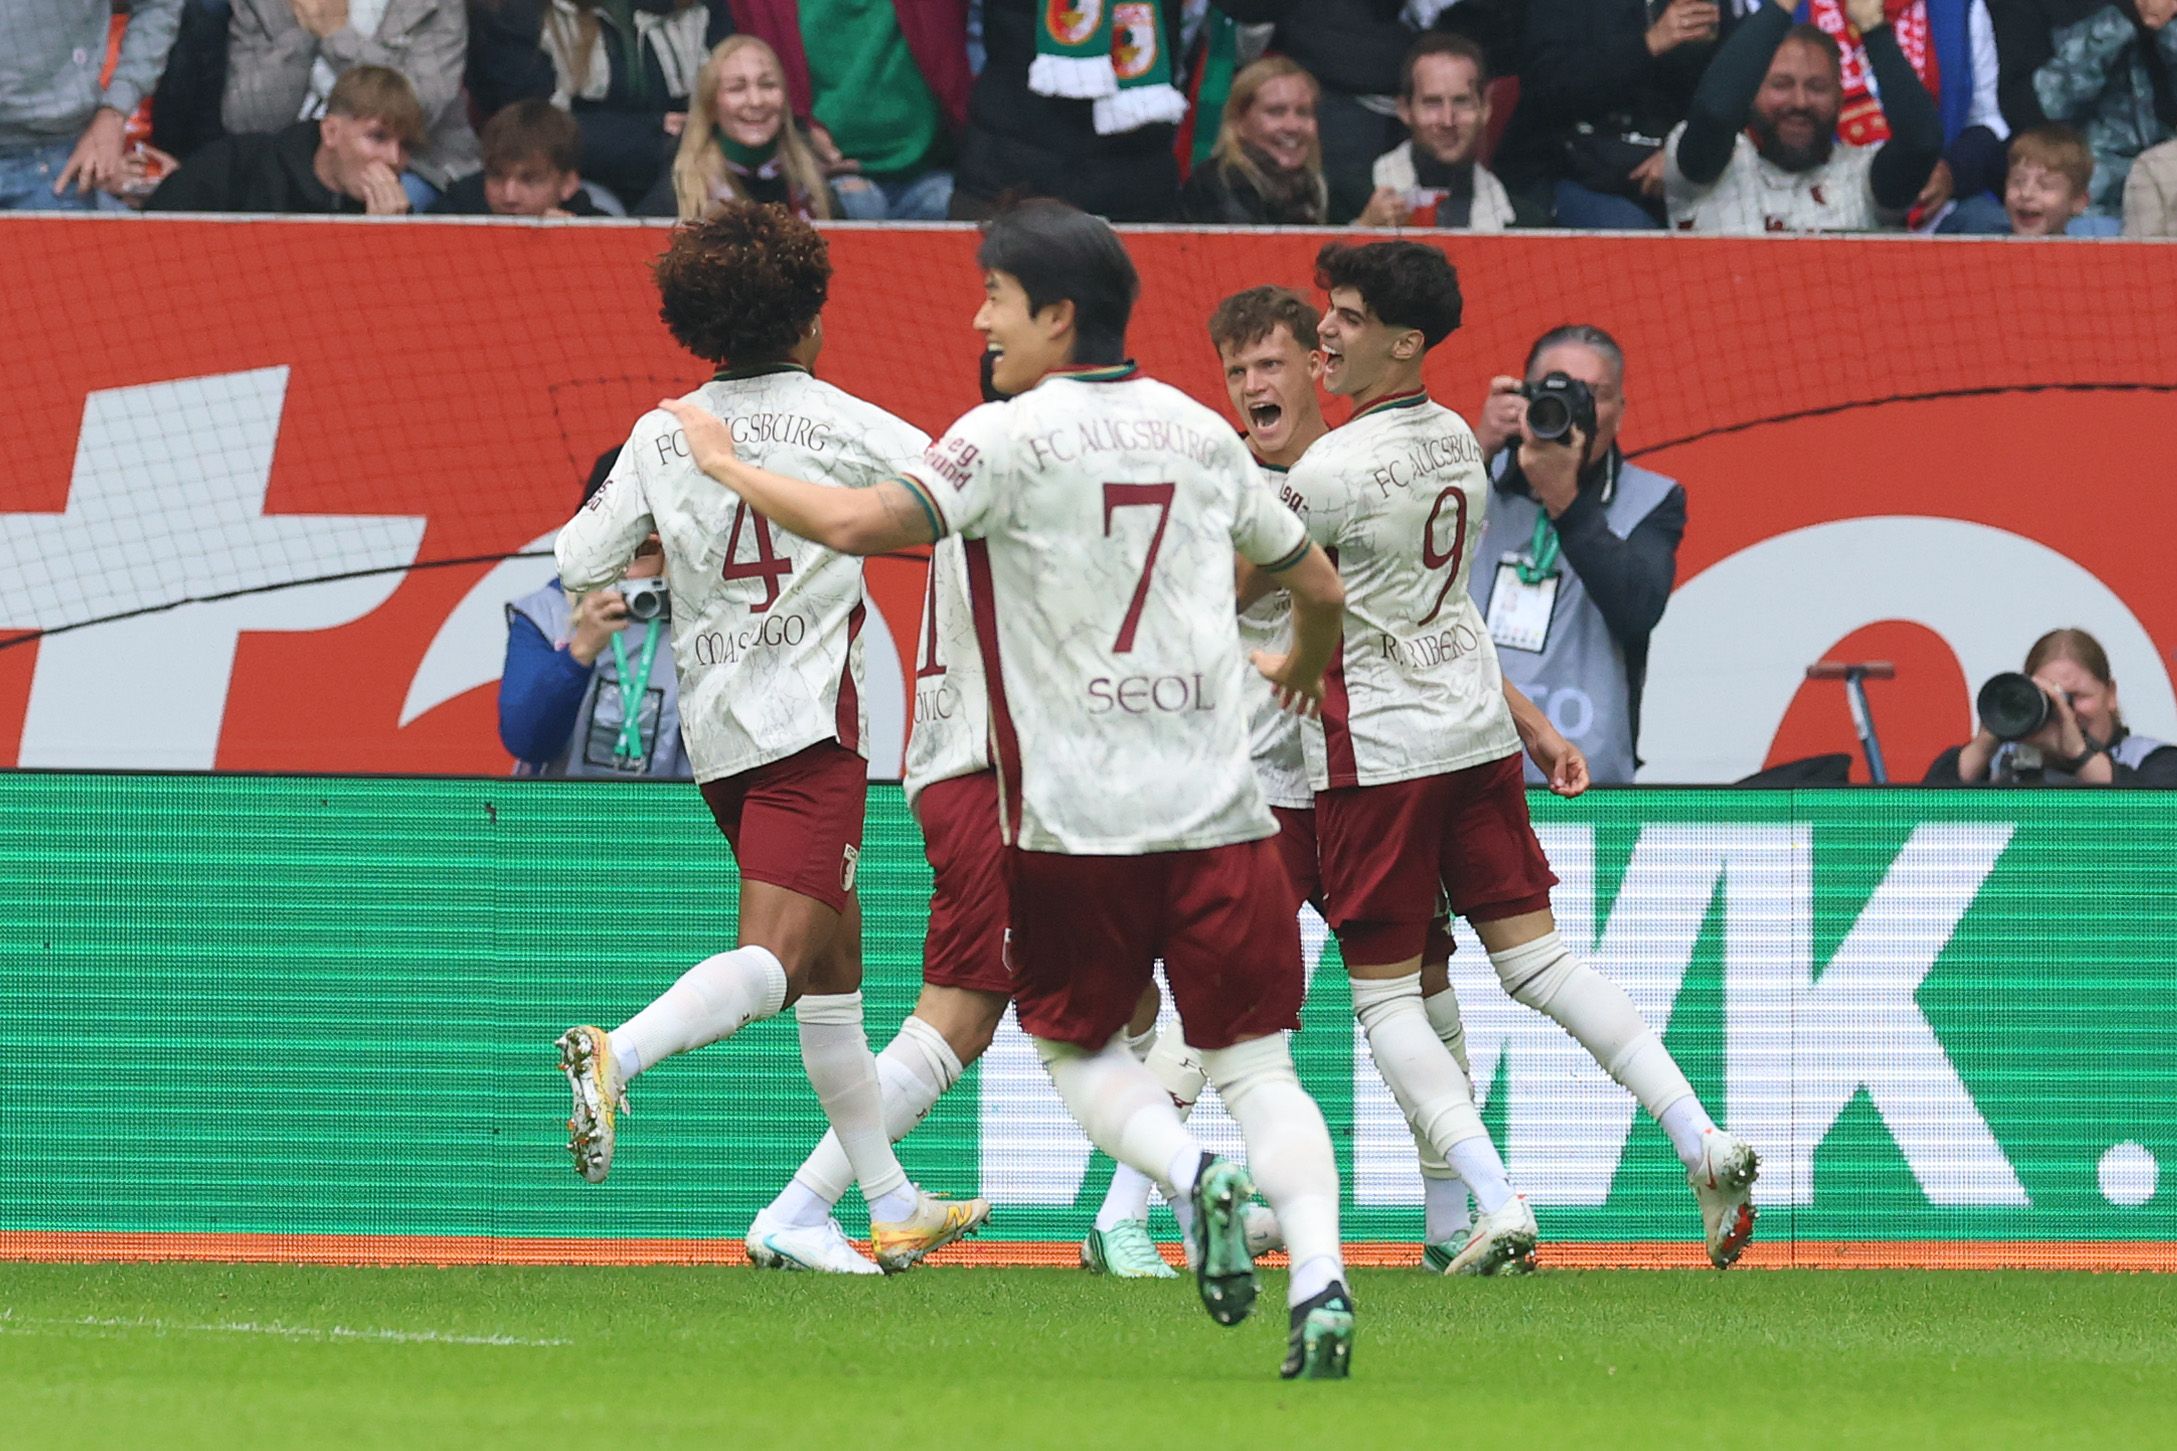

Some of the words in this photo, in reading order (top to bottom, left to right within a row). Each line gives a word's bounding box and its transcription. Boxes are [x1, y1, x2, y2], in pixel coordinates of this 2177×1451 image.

[724, 412, 831, 452] GSBURG
[1029, 429, 1077, 473] FC
[1078, 417, 1220, 471] AUGSBURG
[1373, 459, 1409, 499] FC
[721, 498, 794, 614] 4
[1102, 482, 1176, 653] 7
[1422, 485, 1478, 627] 9
[1380, 632, 1404, 667] R.
[1087, 671, 1216, 716] SEOL
